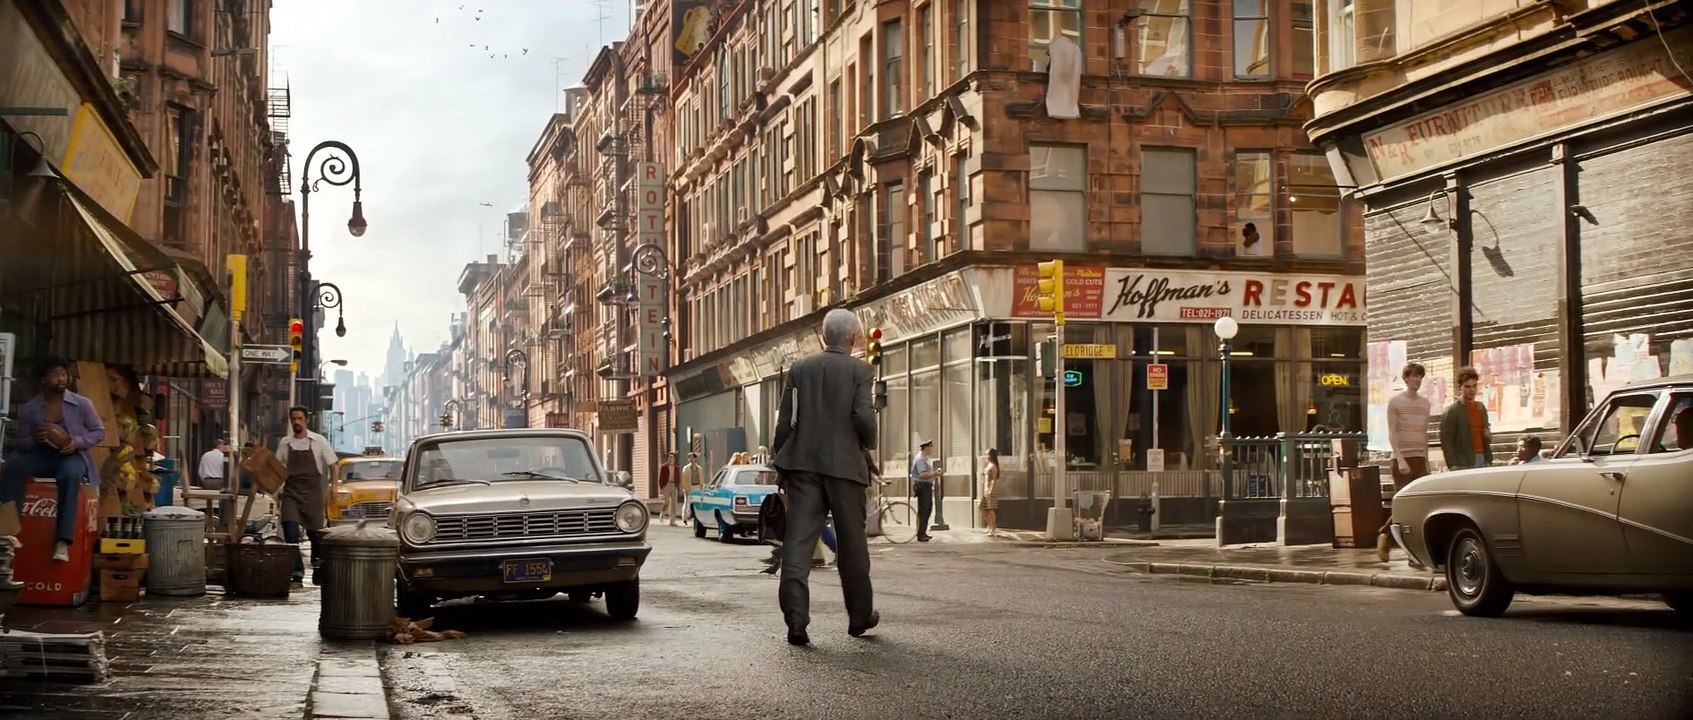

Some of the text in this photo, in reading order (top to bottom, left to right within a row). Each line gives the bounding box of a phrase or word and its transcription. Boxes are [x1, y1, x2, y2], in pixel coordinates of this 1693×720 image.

[645, 165, 659, 371] ROTTEIN
[1107, 274, 1231, 318] Hoffman's
[1243, 279, 1367, 309] RESTA
[1242, 310, 1323, 320] DELICATESSEN
[1331, 312, 1348, 320] HOT
[1065, 345, 1103, 357] ELDRIDGE
[1321, 374, 1347, 386] OPEN
[26, 582, 62, 591] COLD
